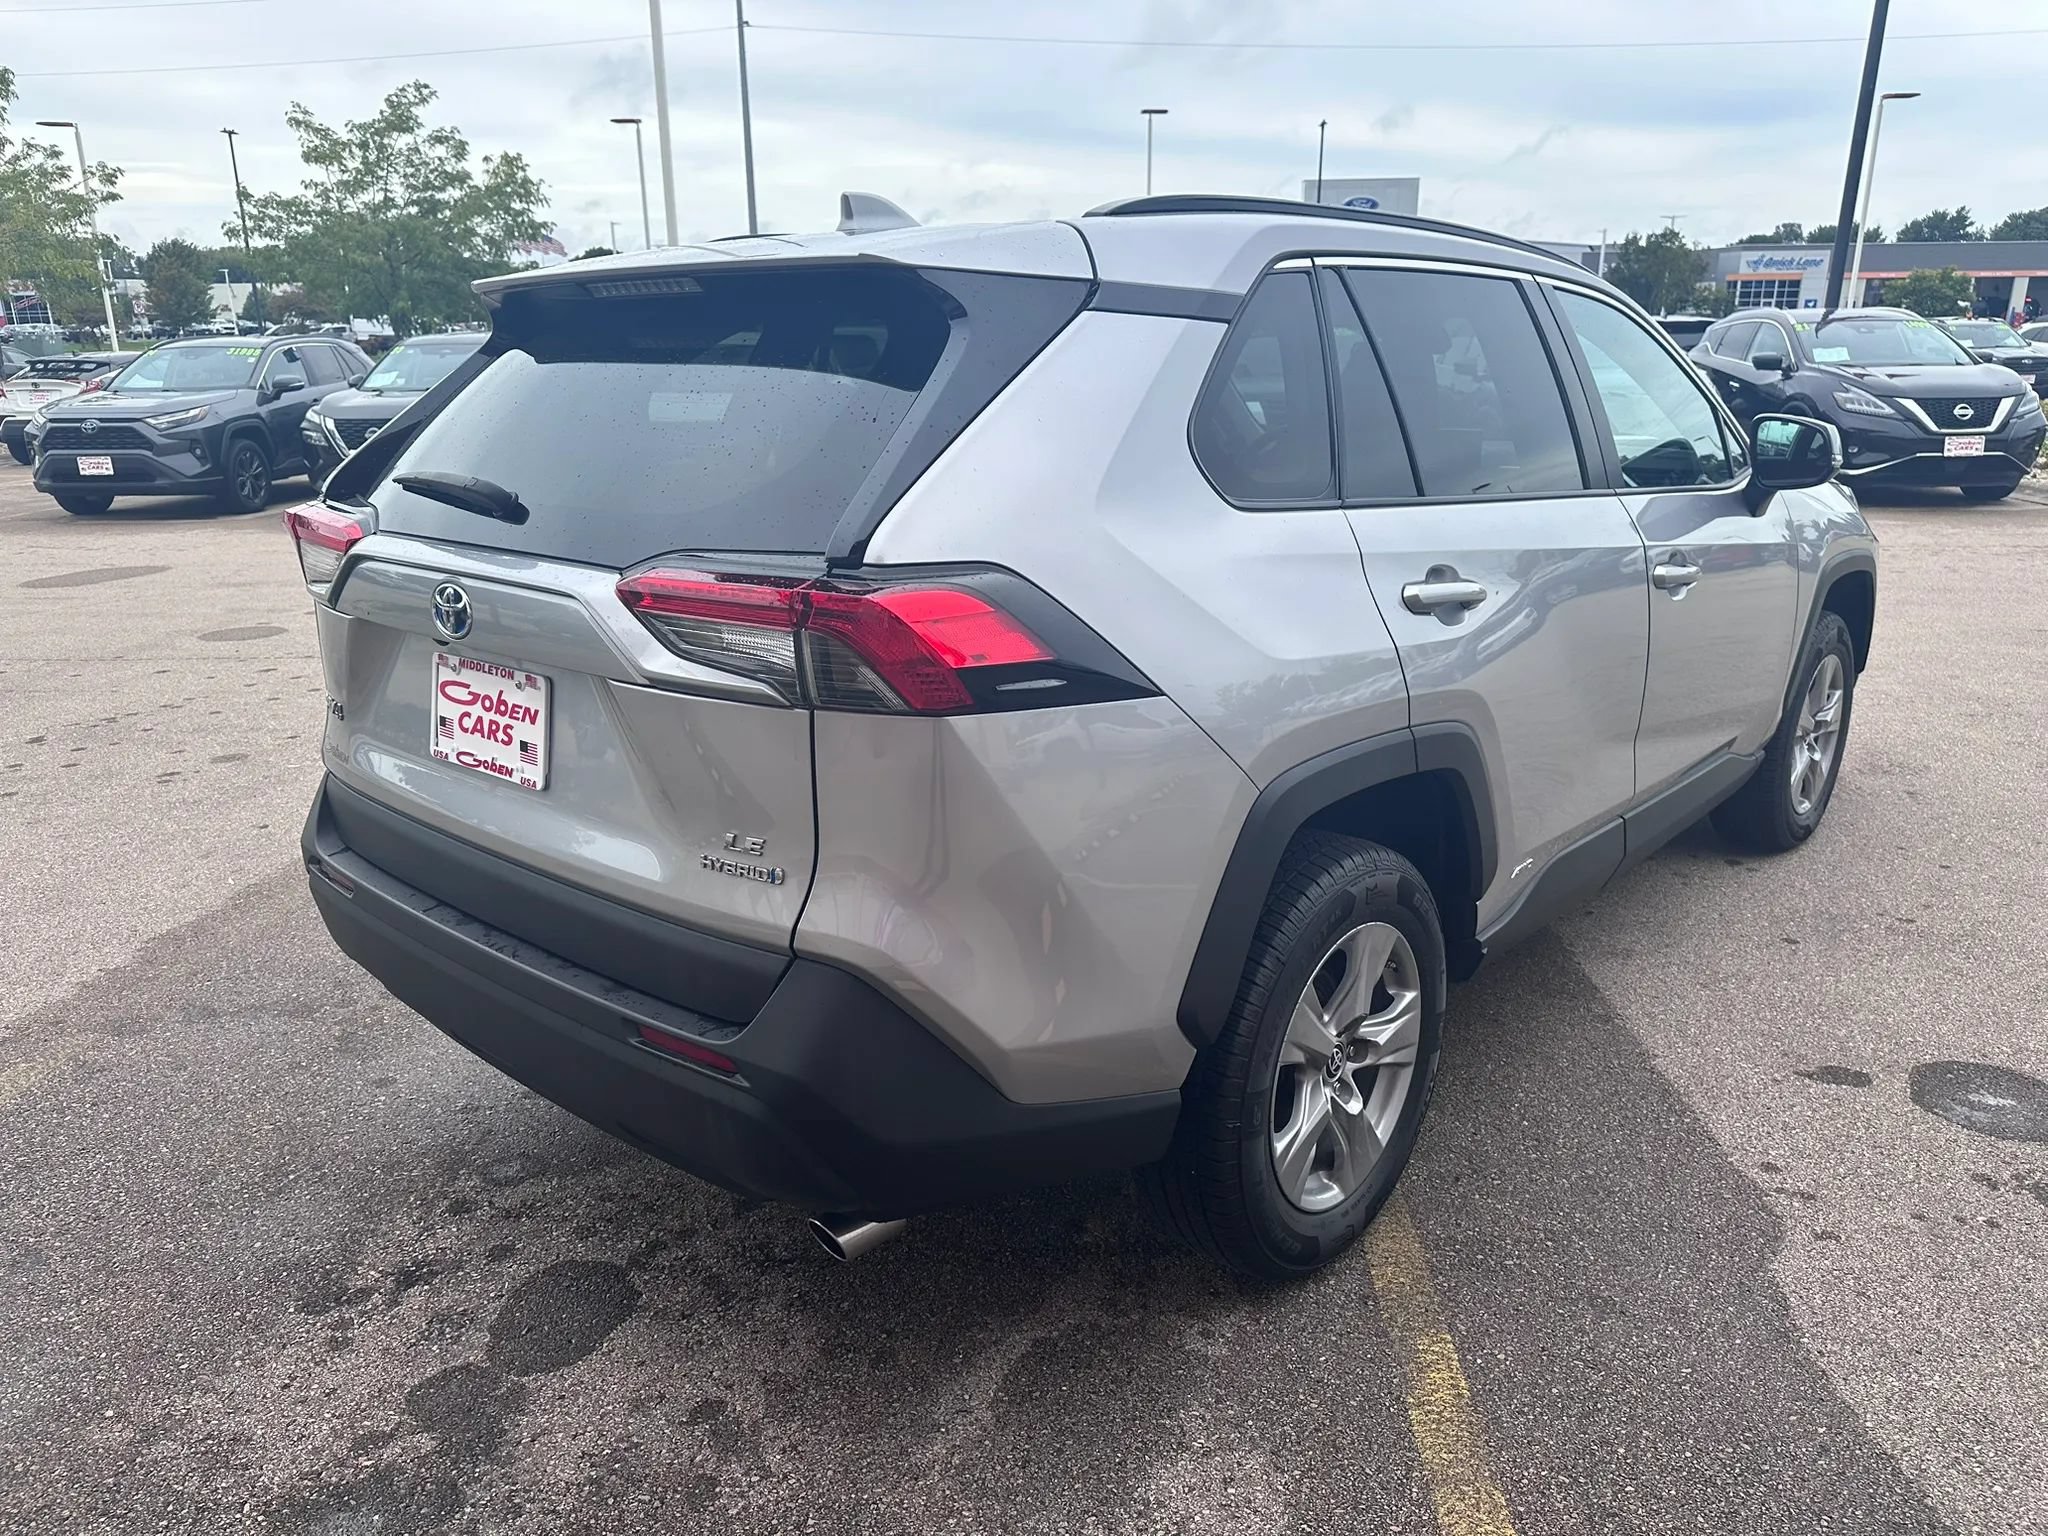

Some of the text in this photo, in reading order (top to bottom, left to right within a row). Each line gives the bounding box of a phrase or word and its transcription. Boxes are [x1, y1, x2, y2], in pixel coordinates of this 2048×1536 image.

[1763, 256, 1825, 269] Quick Lane
[458, 657, 516, 681] MIDDLETON
[457, 711, 515, 747] CARS
[433, 748, 449, 761] USA
[520, 776, 538, 790] USA
[722, 831, 767, 857] LE
[699, 853, 769, 883] HYBRID
